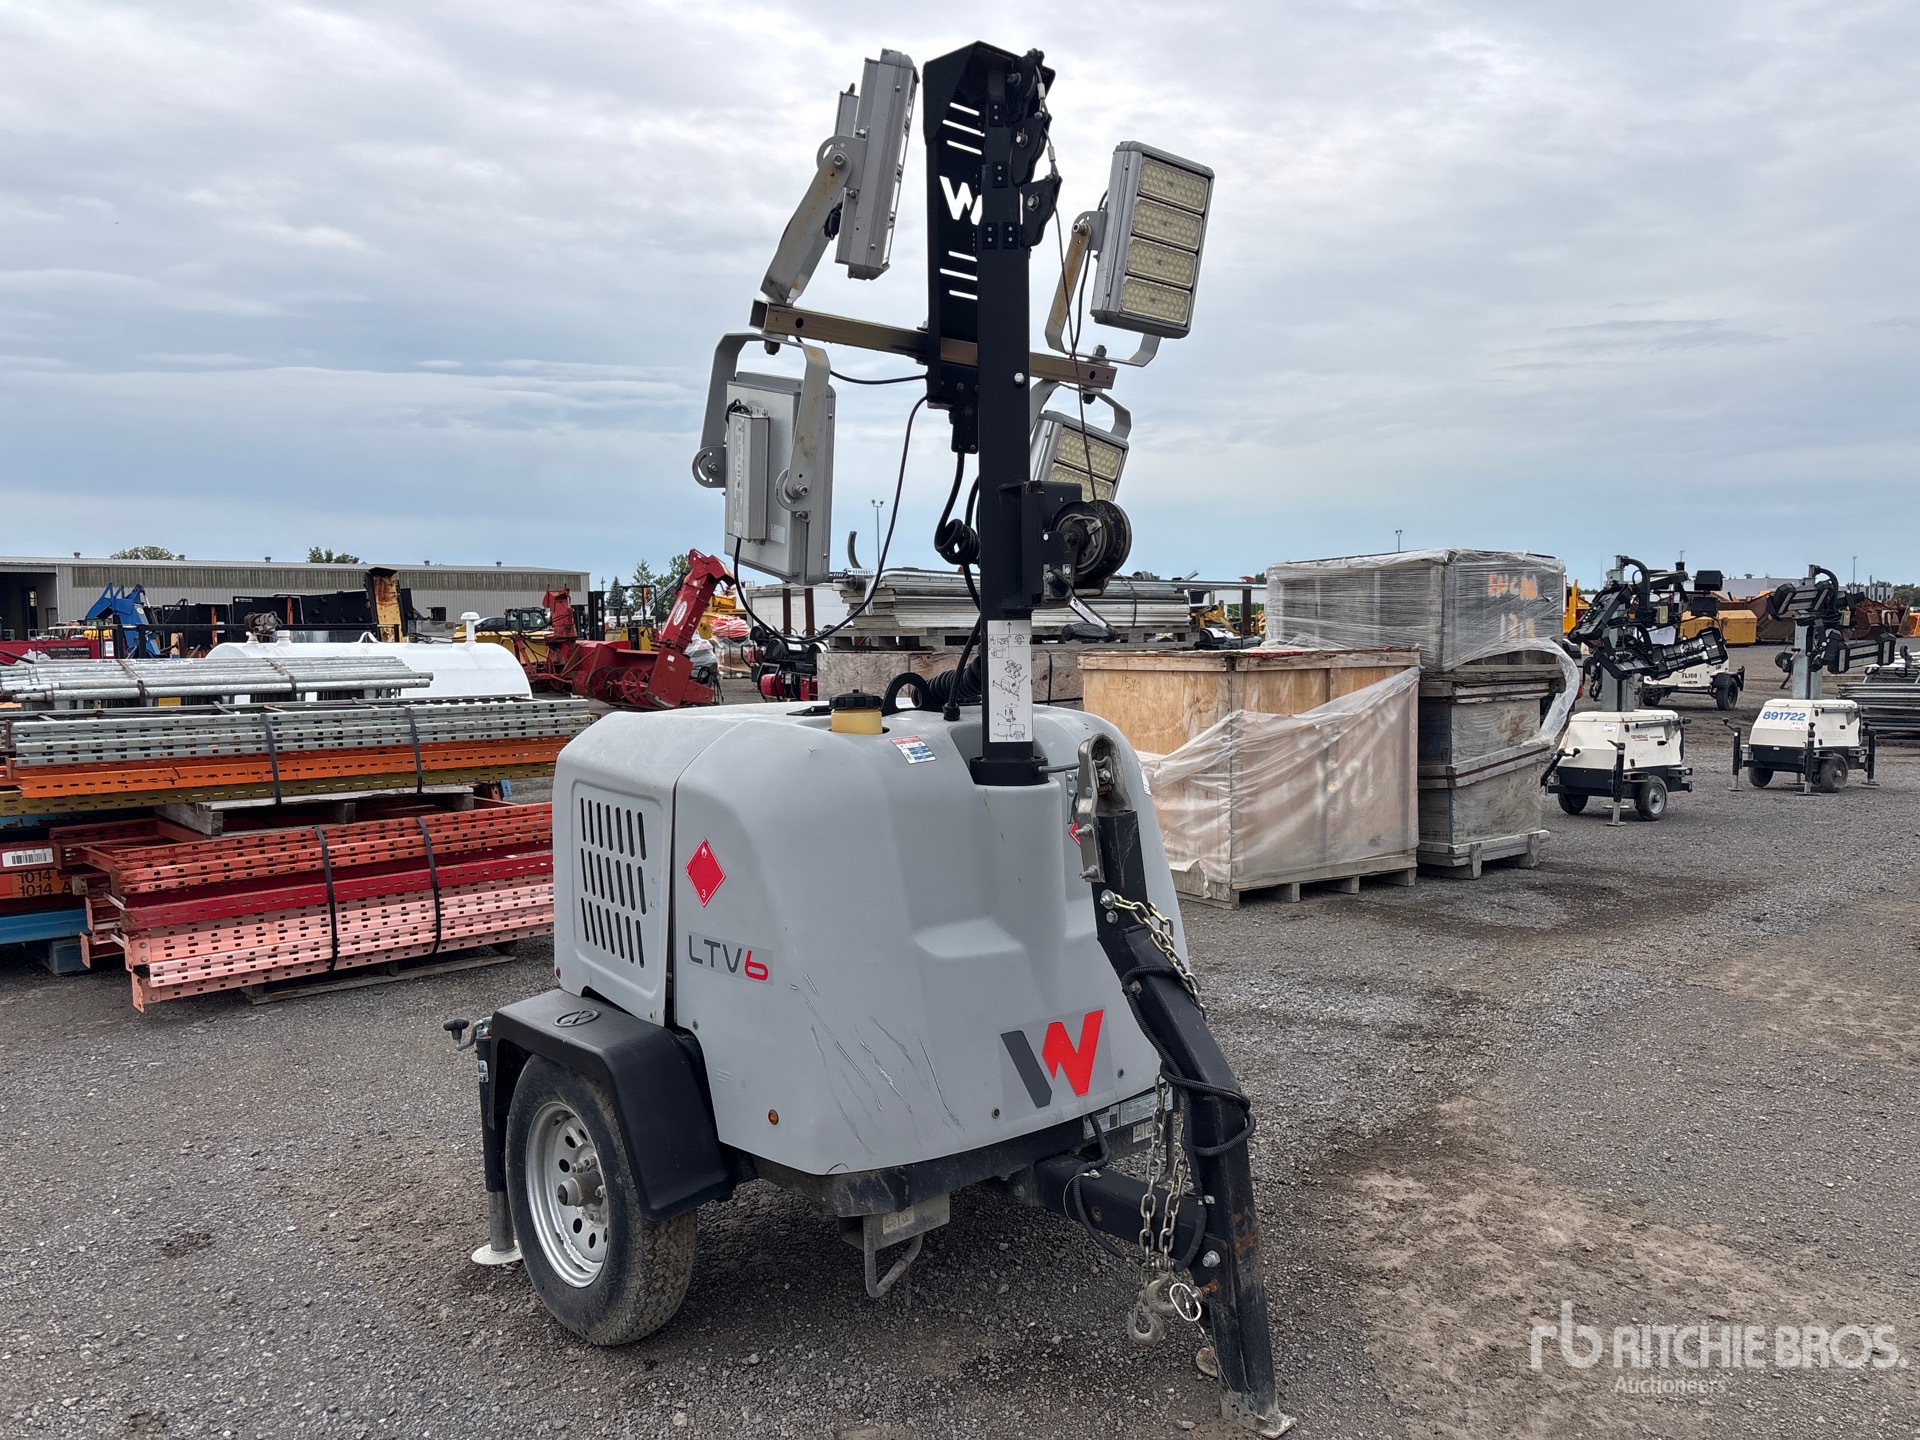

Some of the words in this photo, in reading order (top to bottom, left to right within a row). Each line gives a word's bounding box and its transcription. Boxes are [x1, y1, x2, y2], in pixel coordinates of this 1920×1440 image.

[1762, 711, 1806, 721] 891722
[18, 870, 52, 884] 1014
[19, 884, 53, 897] 1014
[701, 889, 707, 899] 3
